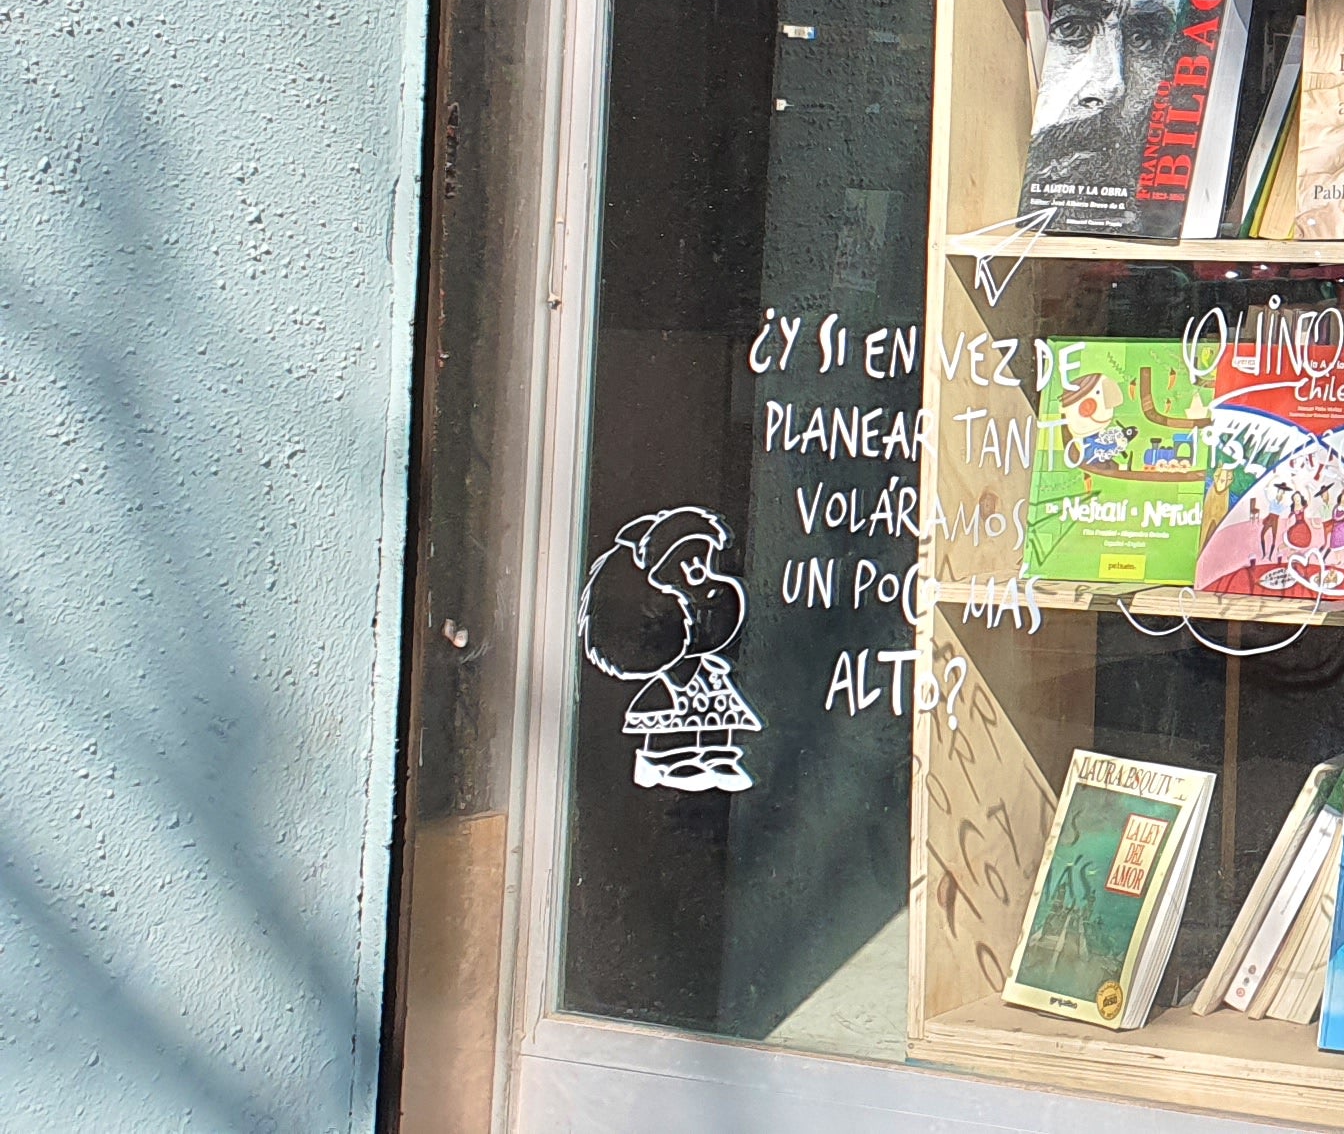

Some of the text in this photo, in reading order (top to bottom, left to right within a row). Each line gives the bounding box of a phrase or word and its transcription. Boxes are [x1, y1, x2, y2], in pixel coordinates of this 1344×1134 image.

[1136, 80, 1172, 201] FRANCISCO
[748, 307, 1086, 393] ¿Y SI EN VEZ DE
[1182, 293, 1344, 383] QUINO
[765, 399, 1092, 475] PLANEAR TANTO
[796, 475, 1026, 551] VOLÁRAMOS
[782, 557, 1044, 635] UN POCO MÁS
[824, 647, 967, 731] ALTO?
[1109, 865, 1145, 891] AMOR
